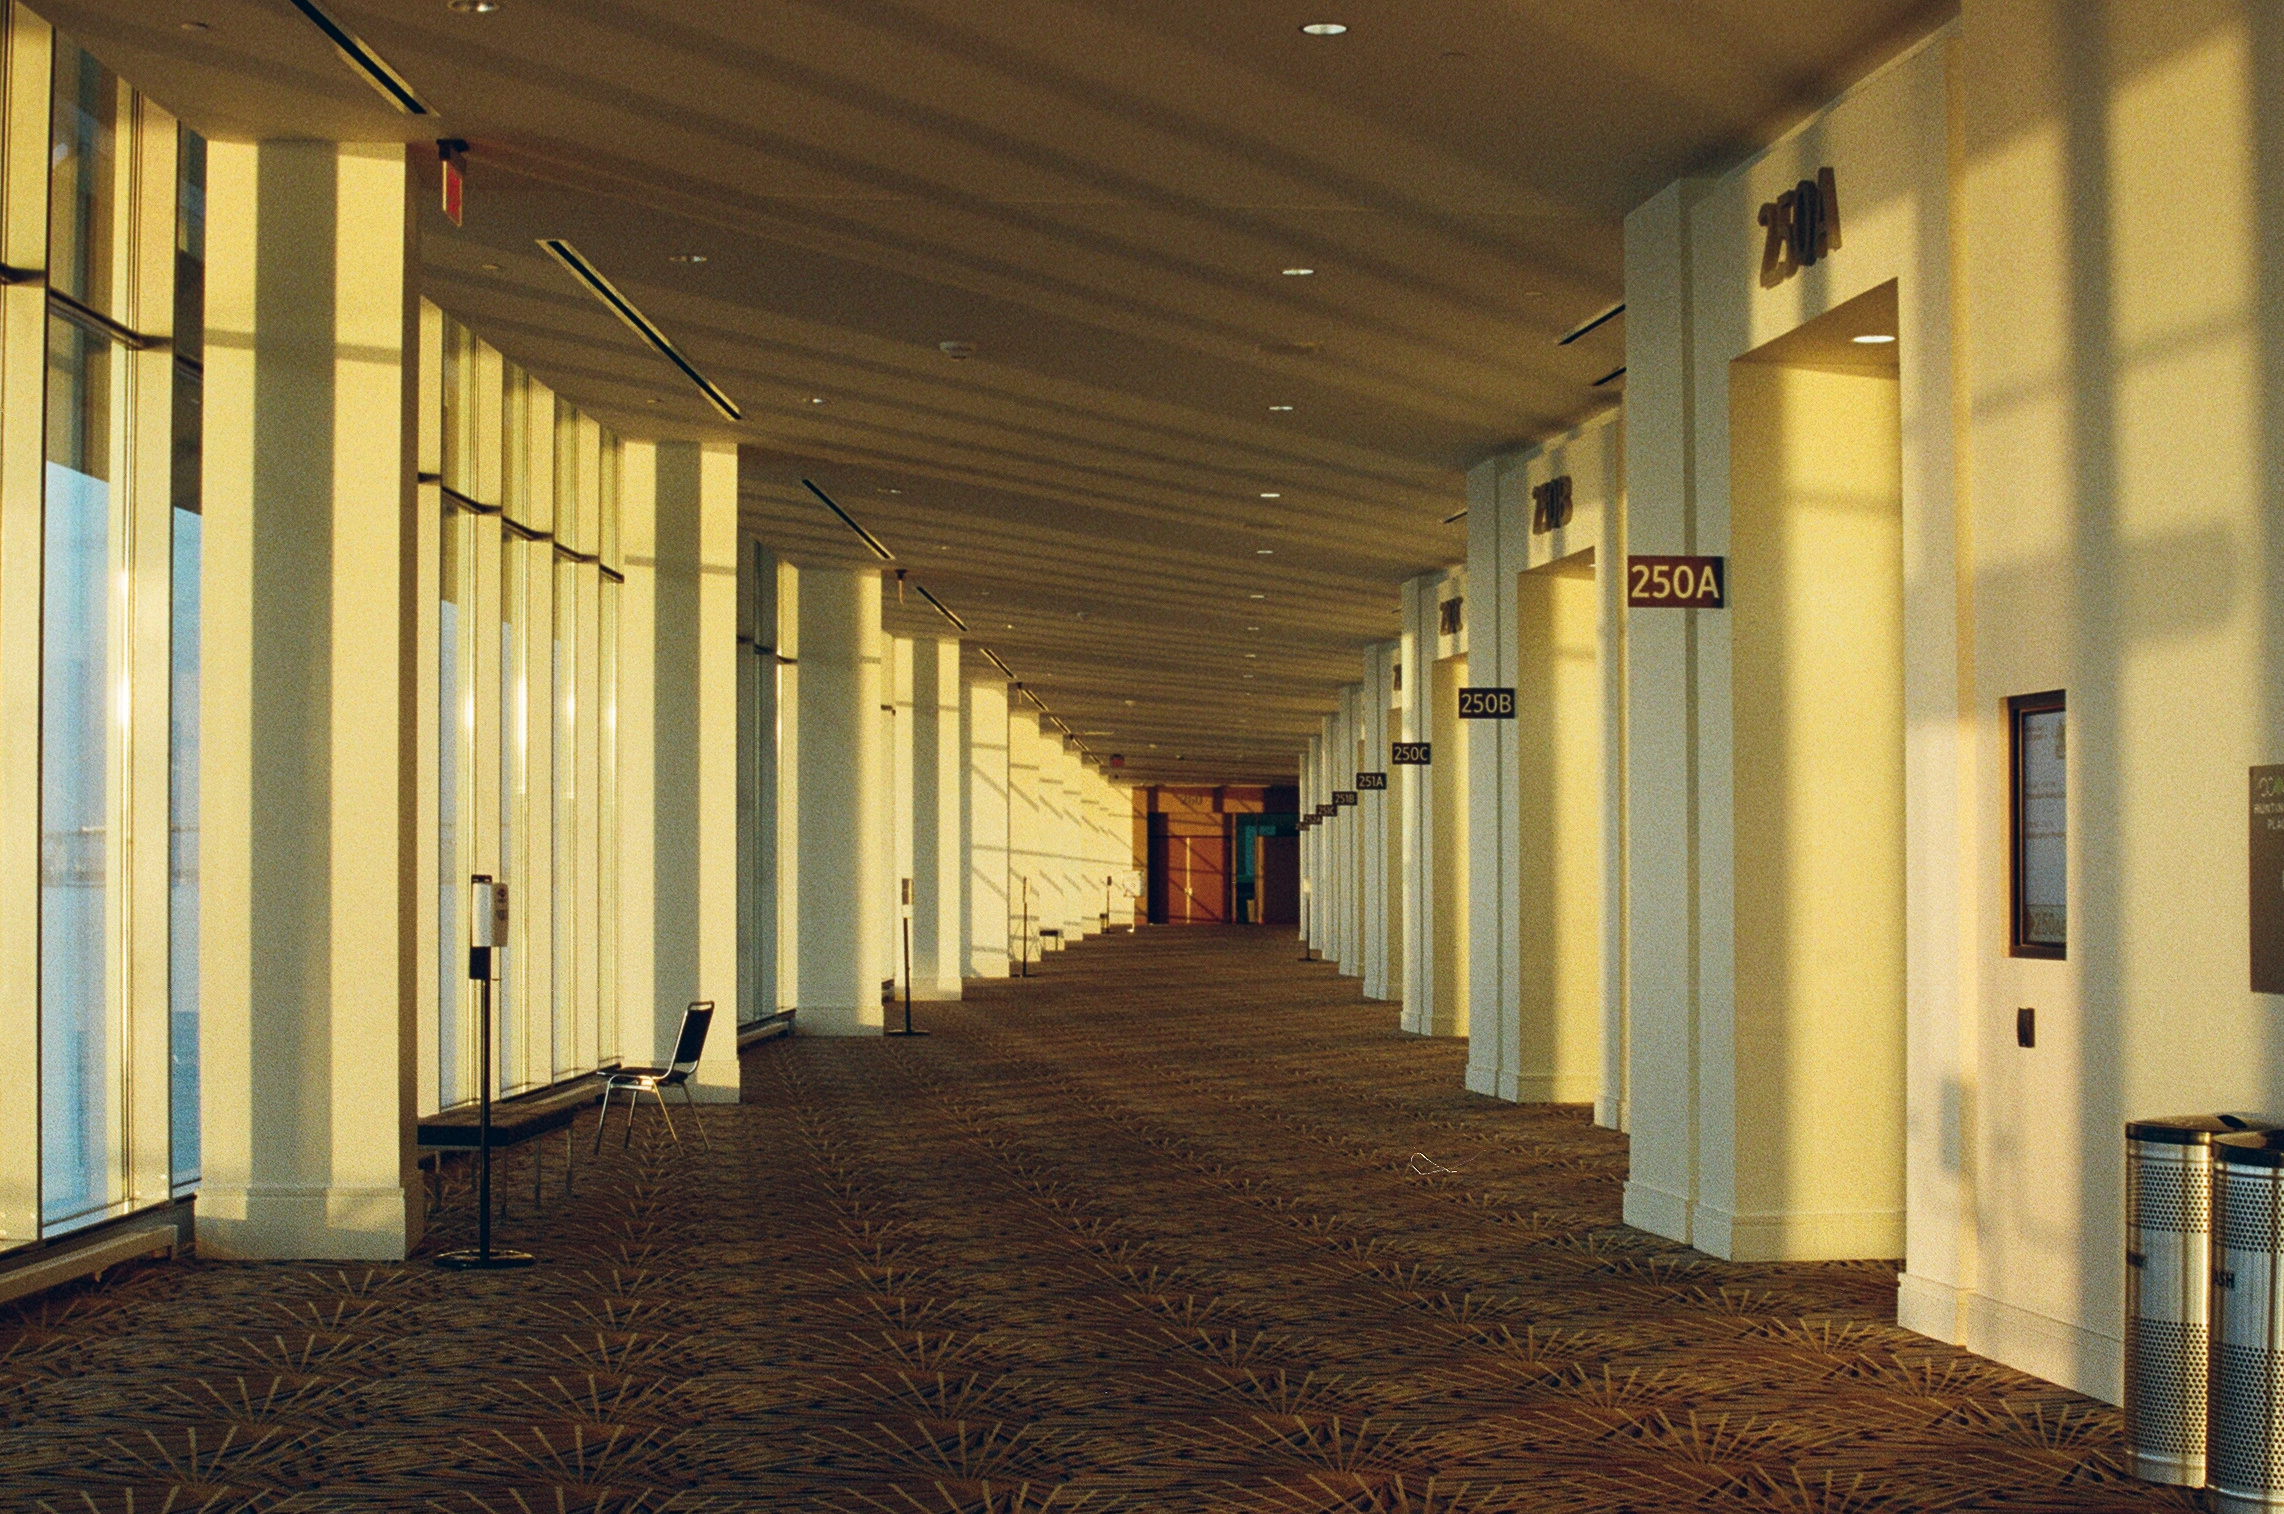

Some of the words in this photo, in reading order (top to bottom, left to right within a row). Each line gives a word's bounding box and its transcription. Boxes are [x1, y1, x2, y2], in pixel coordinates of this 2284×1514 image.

[1631, 564, 1720, 599] 250A
[1461, 693, 1512, 713] 250B
[1394, 746, 1428, 761] 250C
[1358, 775, 1384, 787] 251A
